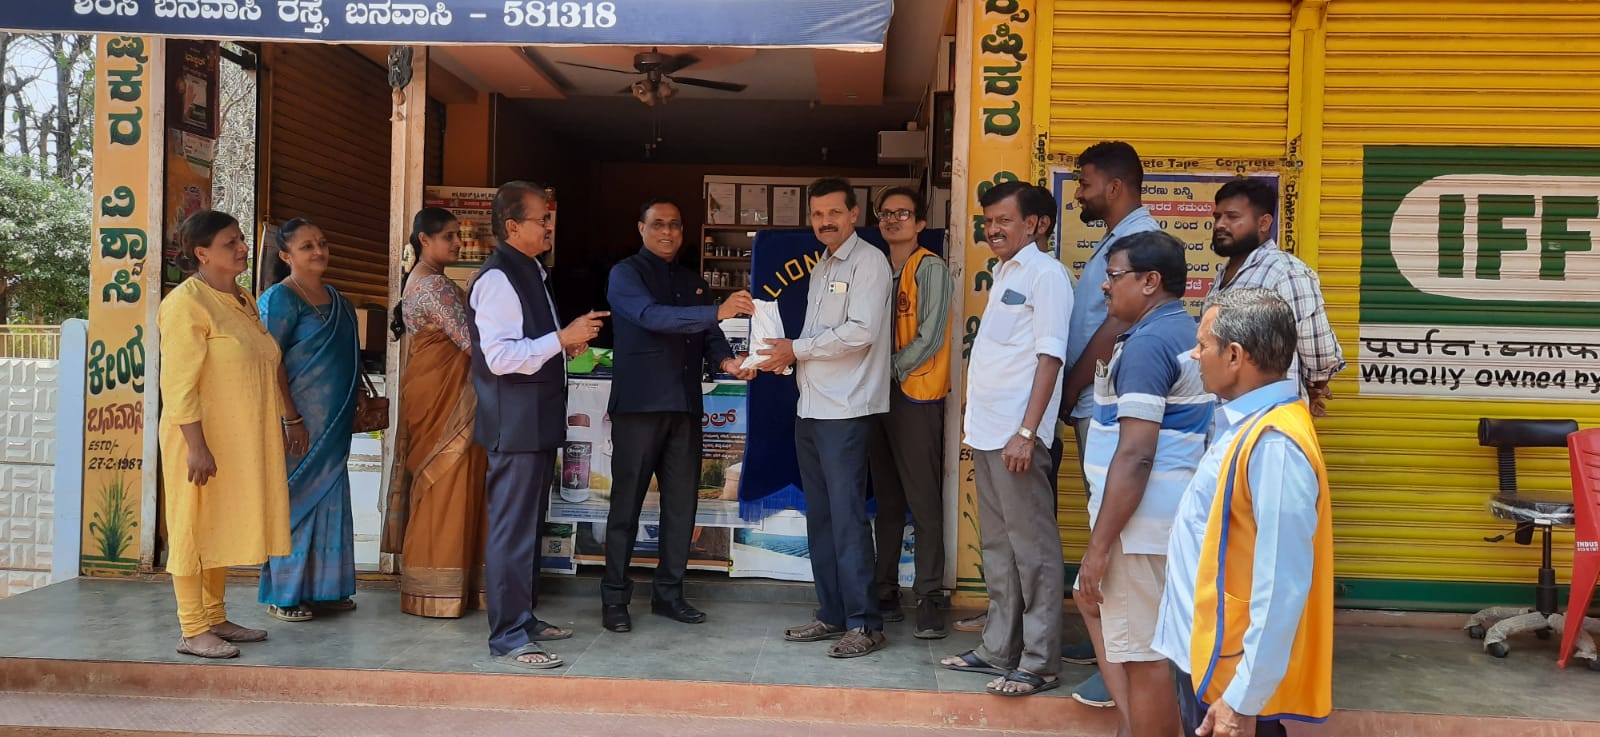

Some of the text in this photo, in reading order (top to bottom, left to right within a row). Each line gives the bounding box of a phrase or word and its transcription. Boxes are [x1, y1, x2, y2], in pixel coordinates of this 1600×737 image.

[154, 0, 262, 21] ಬನವಾಸಿ
[345, 2, 453, 26] ಬನವಾಸಿ
[503, 1, 617, 28] 581318
[1168, 158, 1200, 169] Tape
[1215, 157, 1275, 168] Concrete
[1360, 364, 1465, 391] Wholly
[1474, 368, 1566, 389] owned
